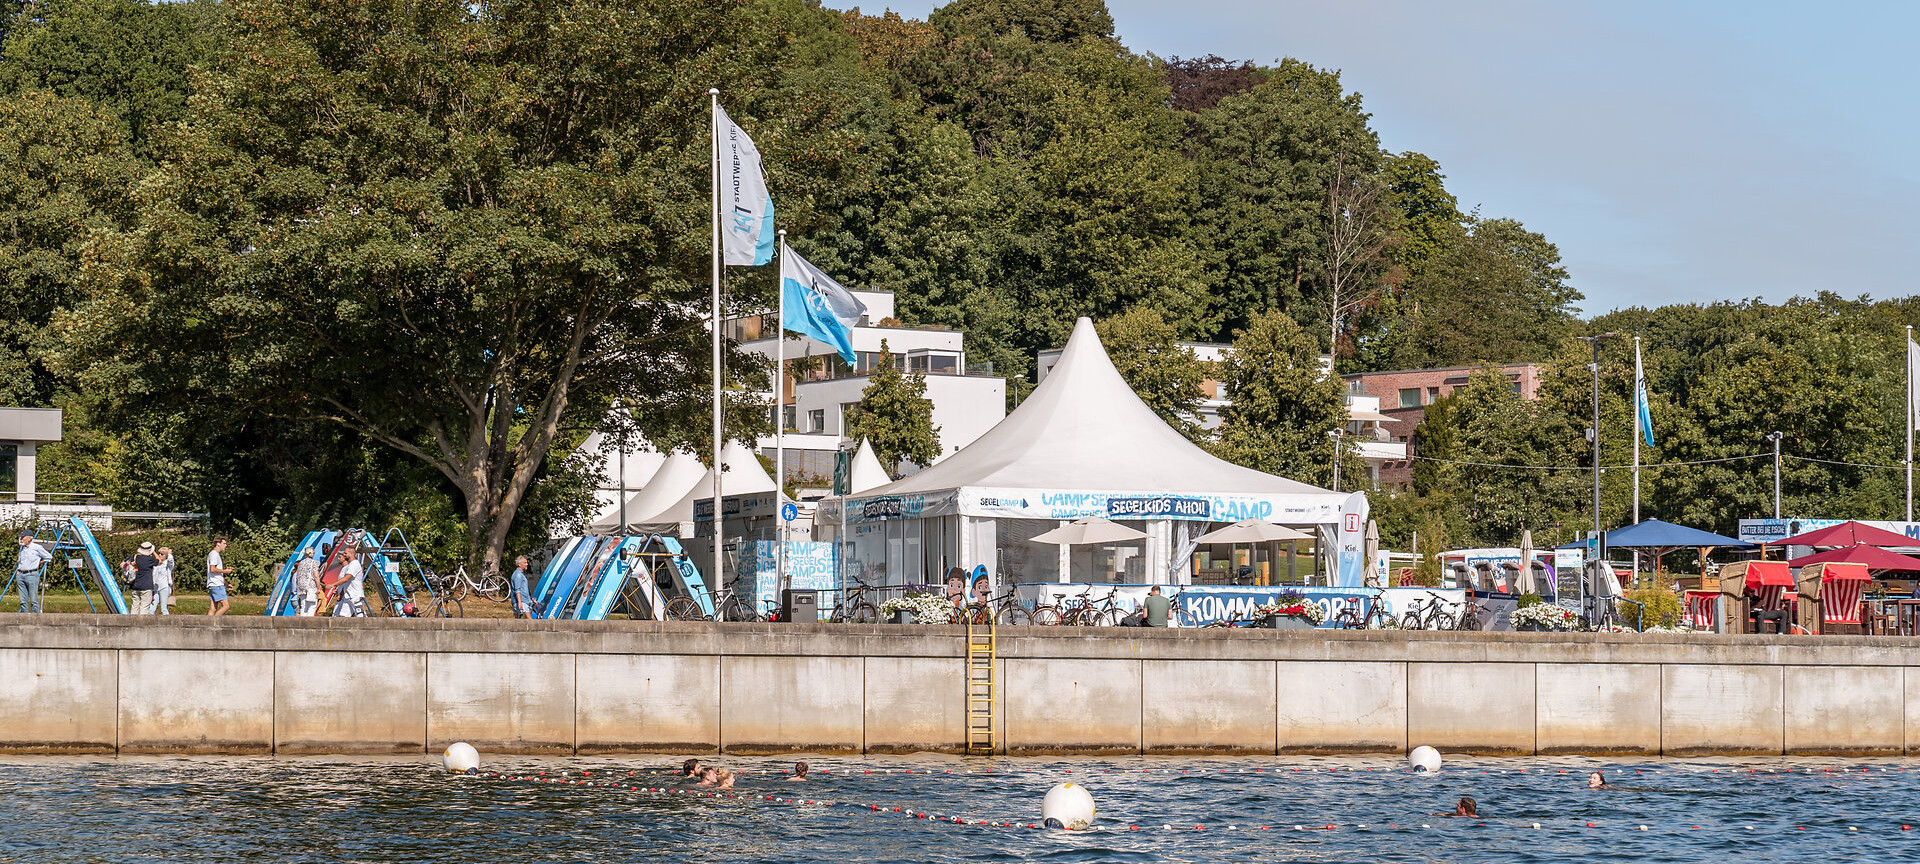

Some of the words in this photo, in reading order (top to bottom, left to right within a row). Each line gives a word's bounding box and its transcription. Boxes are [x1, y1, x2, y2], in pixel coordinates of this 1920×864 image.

[1112, 500, 1171, 514] SEGELKIDS
[1212, 500, 1272, 522] CAMP
[1187, 596, 1254, 621] KOMM
